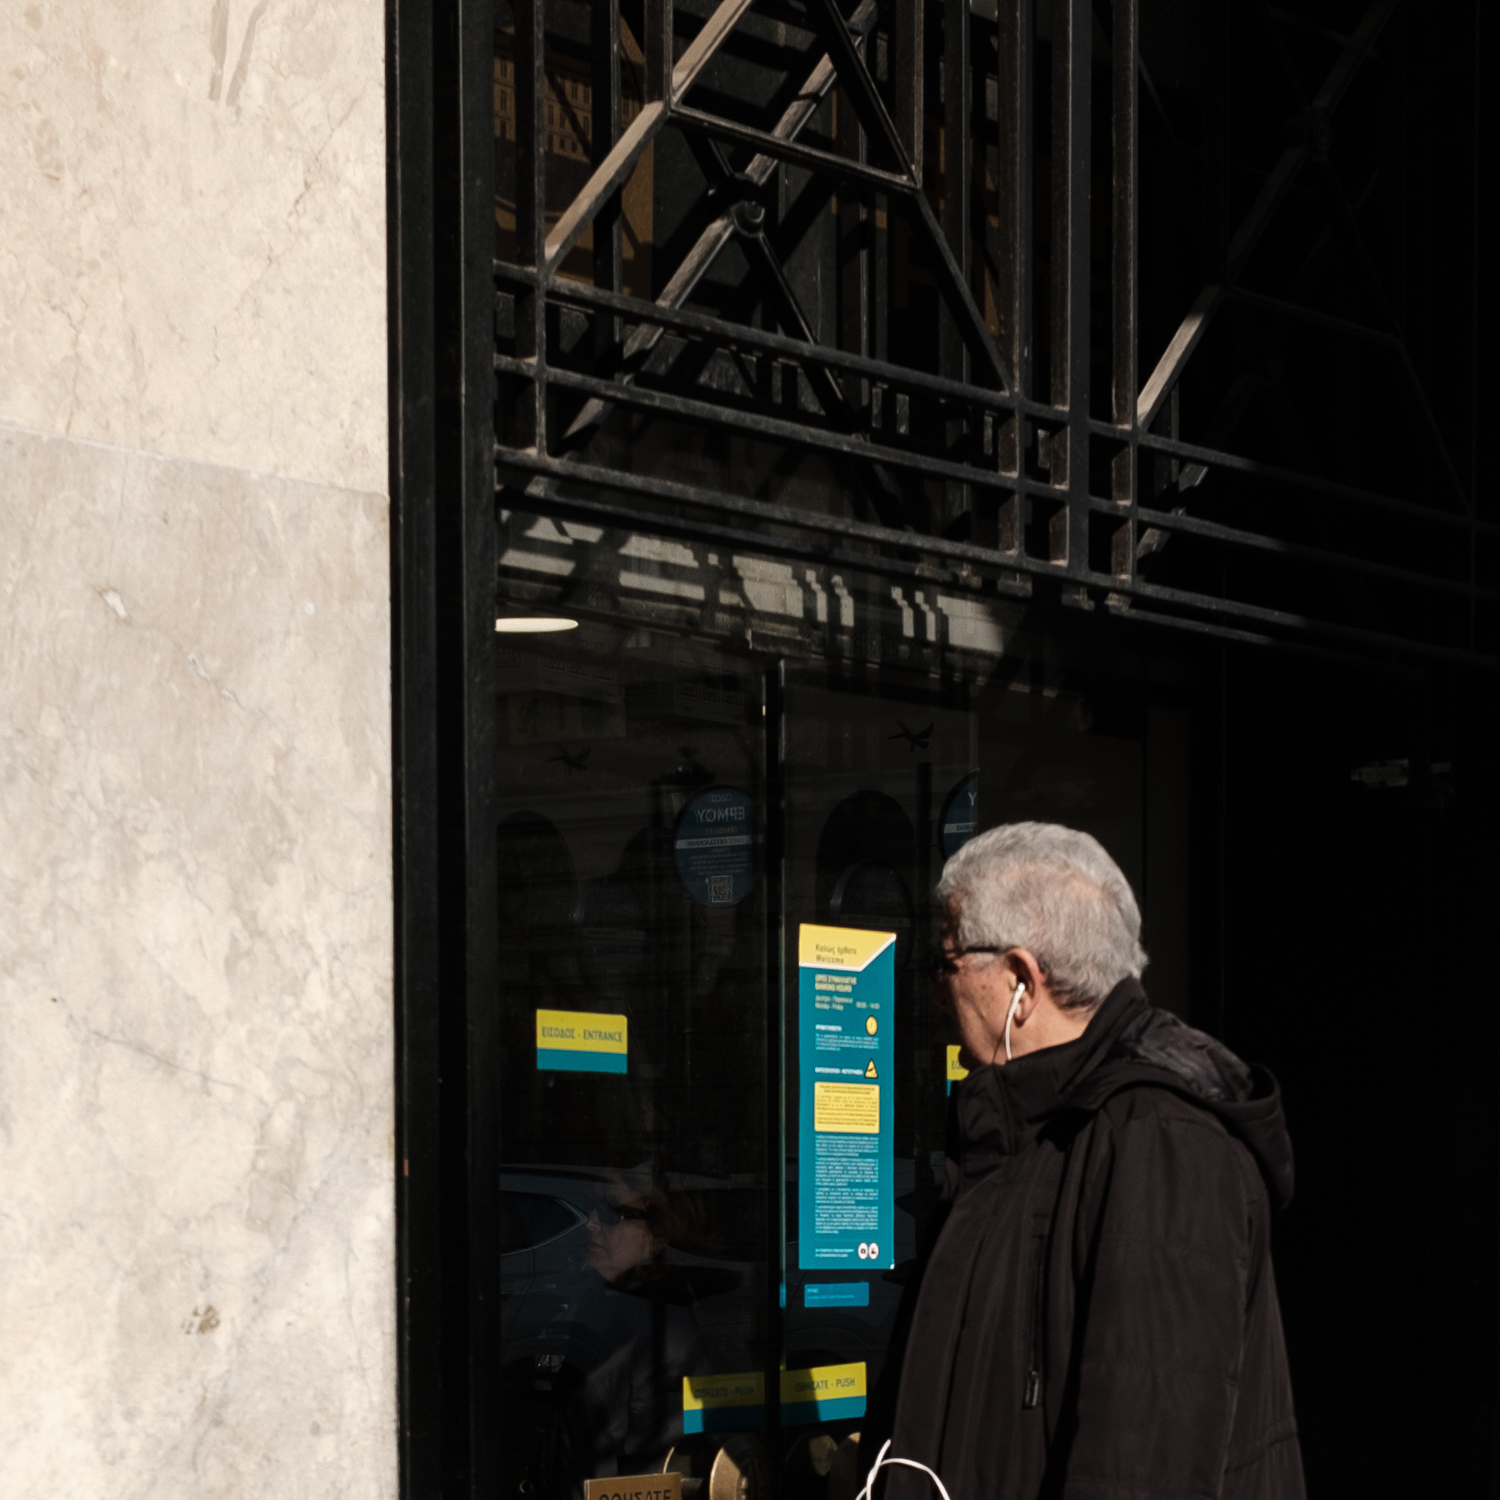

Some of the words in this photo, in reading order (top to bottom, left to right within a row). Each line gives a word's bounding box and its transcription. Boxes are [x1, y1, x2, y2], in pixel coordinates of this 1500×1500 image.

[542, 1027, 575, 1039] ΕΙΣΟΔΟΣ
[583, 1029, 622, 1042] ENTRANCE
[836, 1377, 855, 1388] PUSH
